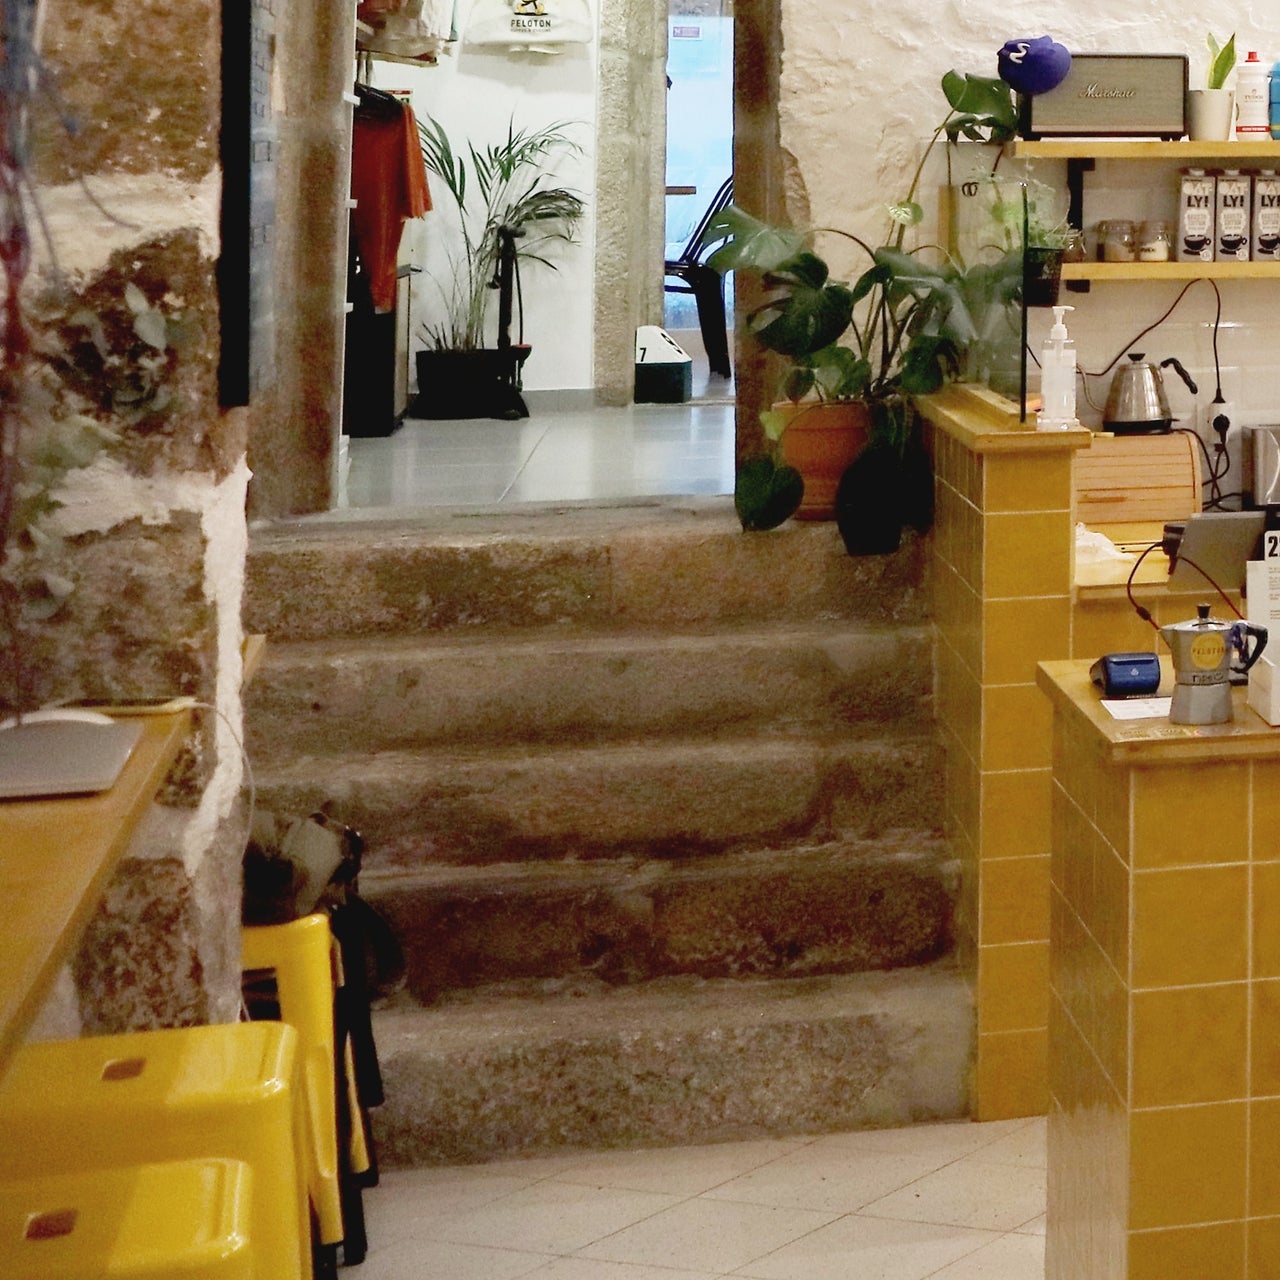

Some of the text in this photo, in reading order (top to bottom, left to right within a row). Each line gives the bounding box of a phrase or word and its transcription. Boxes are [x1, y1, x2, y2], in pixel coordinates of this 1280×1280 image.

[511, 20, 551, 28] PELOTON
[1187, 195, 1209, 208] LY!
[1223, 195, 1245, 208] LY!
[639, 347, 647, 362] 7
